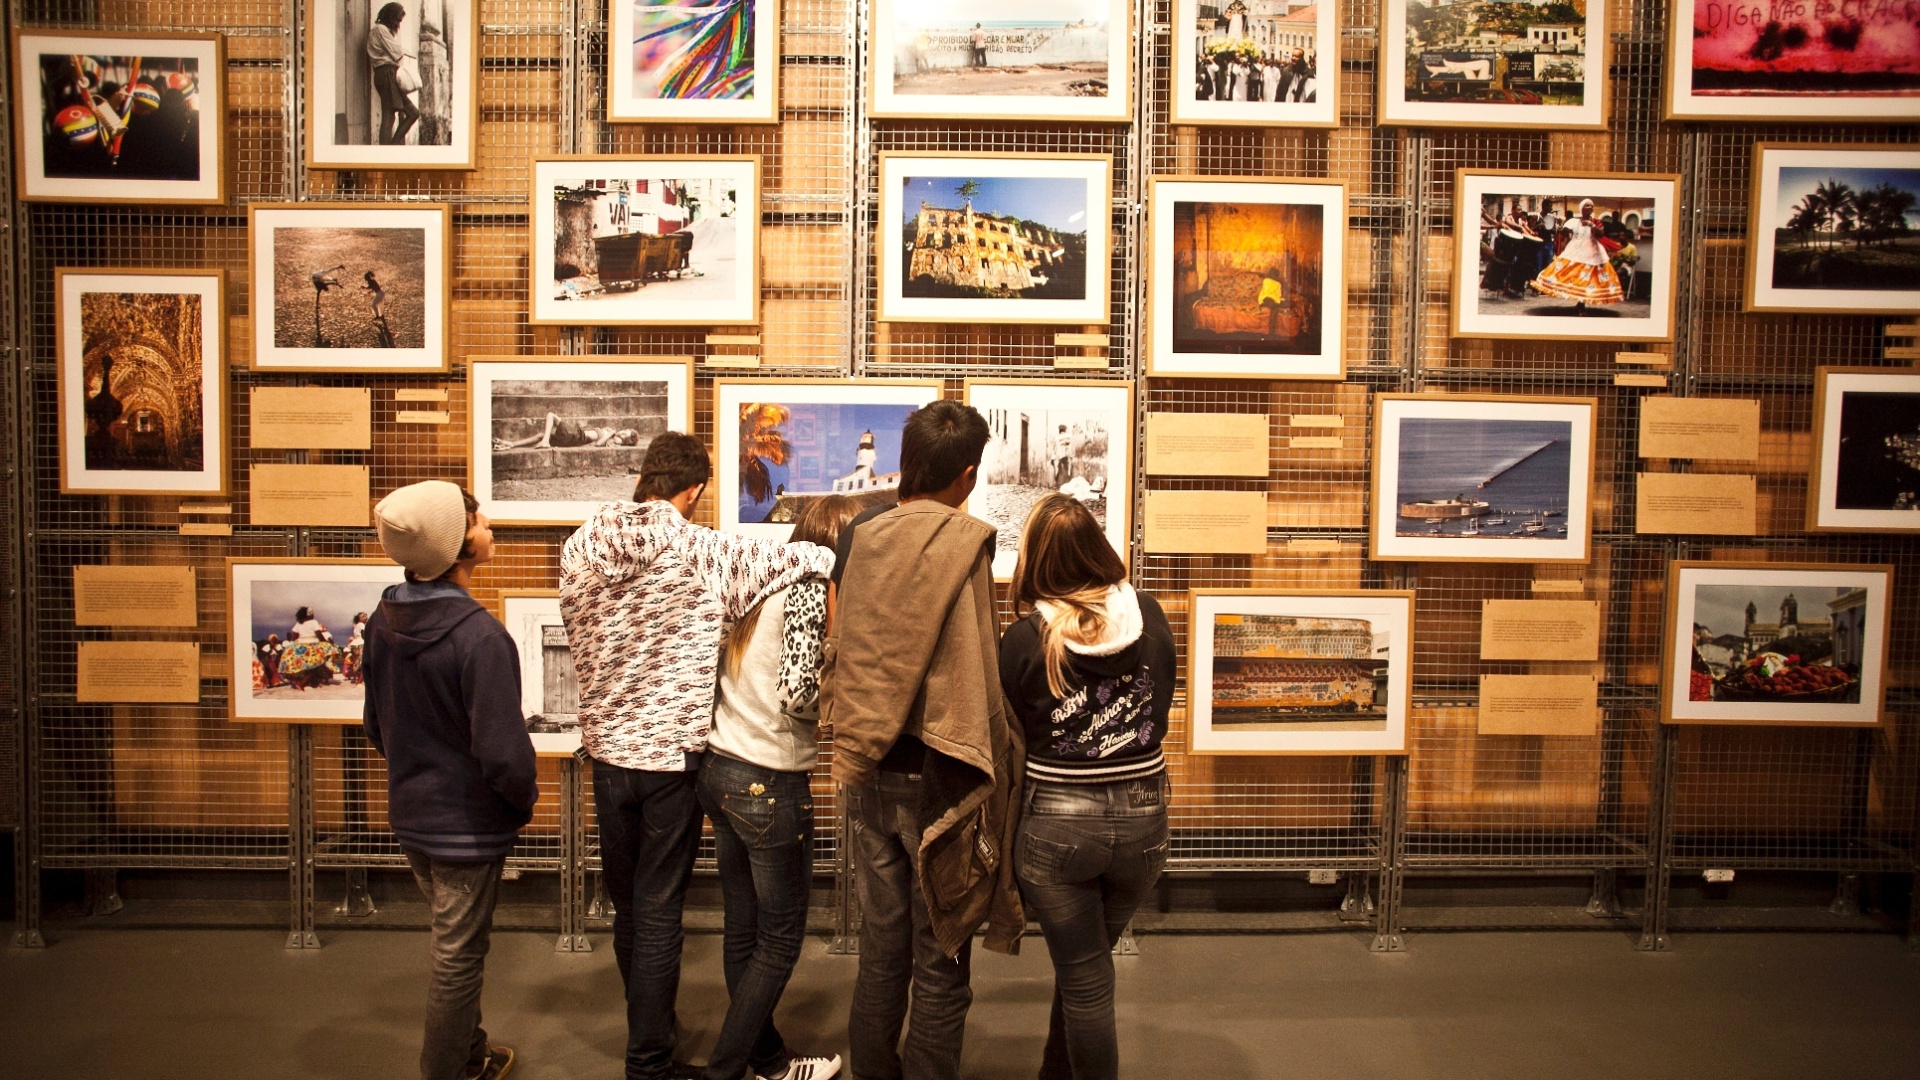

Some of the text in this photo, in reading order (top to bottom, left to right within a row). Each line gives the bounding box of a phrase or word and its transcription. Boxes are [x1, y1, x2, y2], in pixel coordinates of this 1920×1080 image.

[1707, 3, 1762, 29] DIGA
[1770, 0, 1806, 21] NÃO
[932, 35, 969, 45] PROIBIDO
[1086, 702, 1122, 736] Aloha
[1099, 727, 1138, 751] Hawaii
